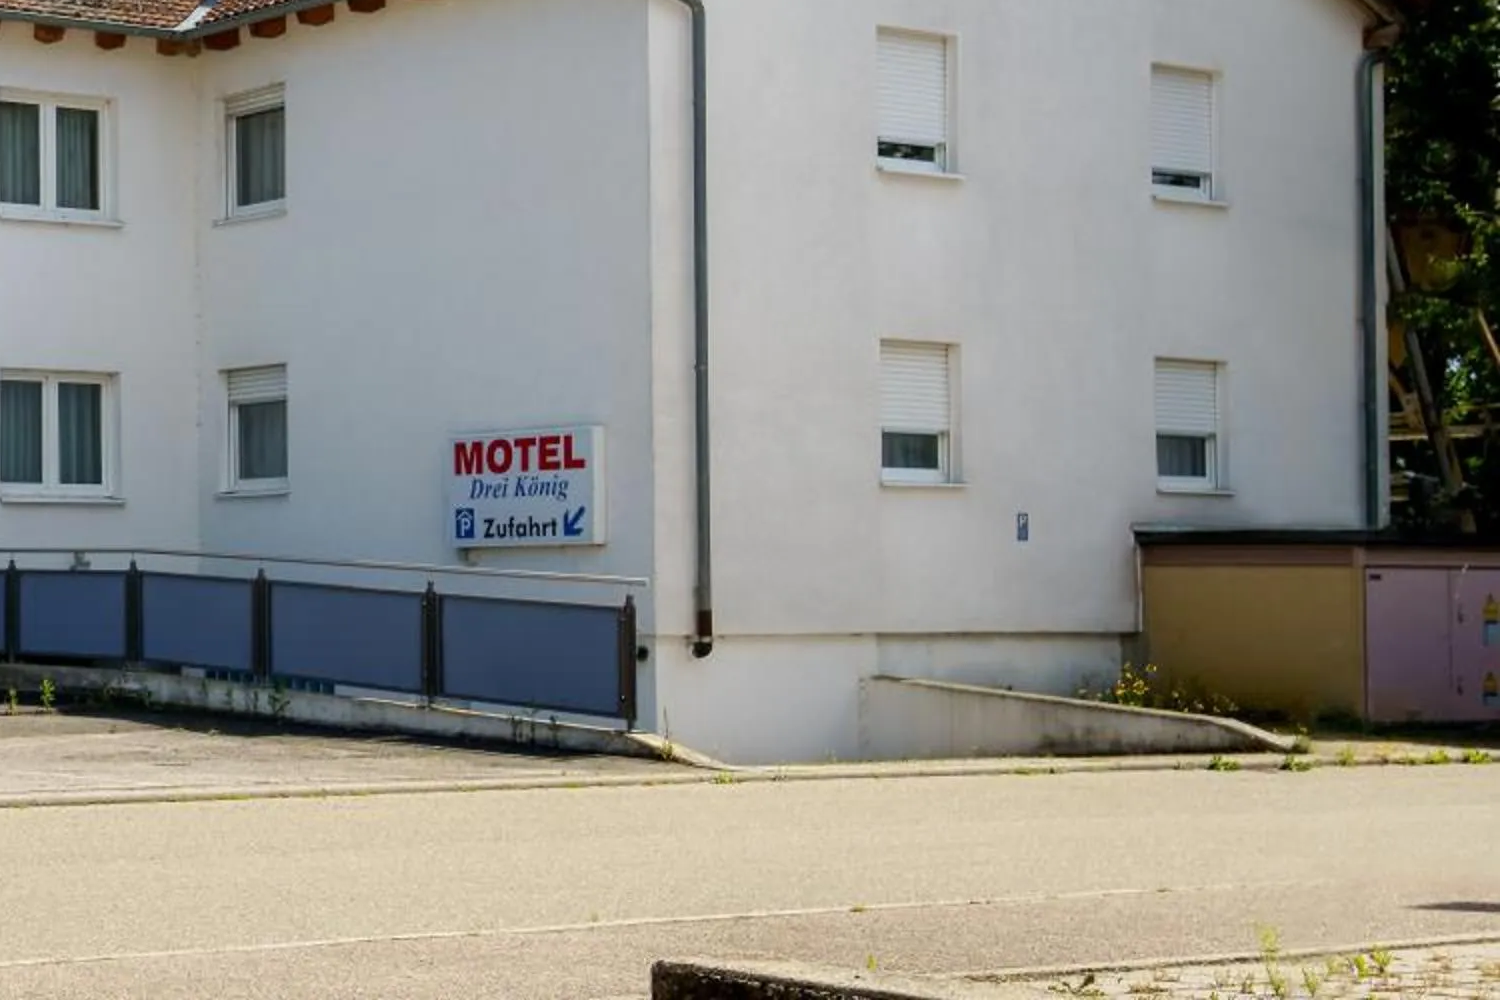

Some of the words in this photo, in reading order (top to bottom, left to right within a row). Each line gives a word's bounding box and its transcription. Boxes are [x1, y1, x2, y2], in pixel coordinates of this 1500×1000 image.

[454, 434, 586, 476] MOTEL
[470, 477, 509, 500] Drei
[514, 474, 569, 501] König
[483, 515, 558, 539] Zufahrt
